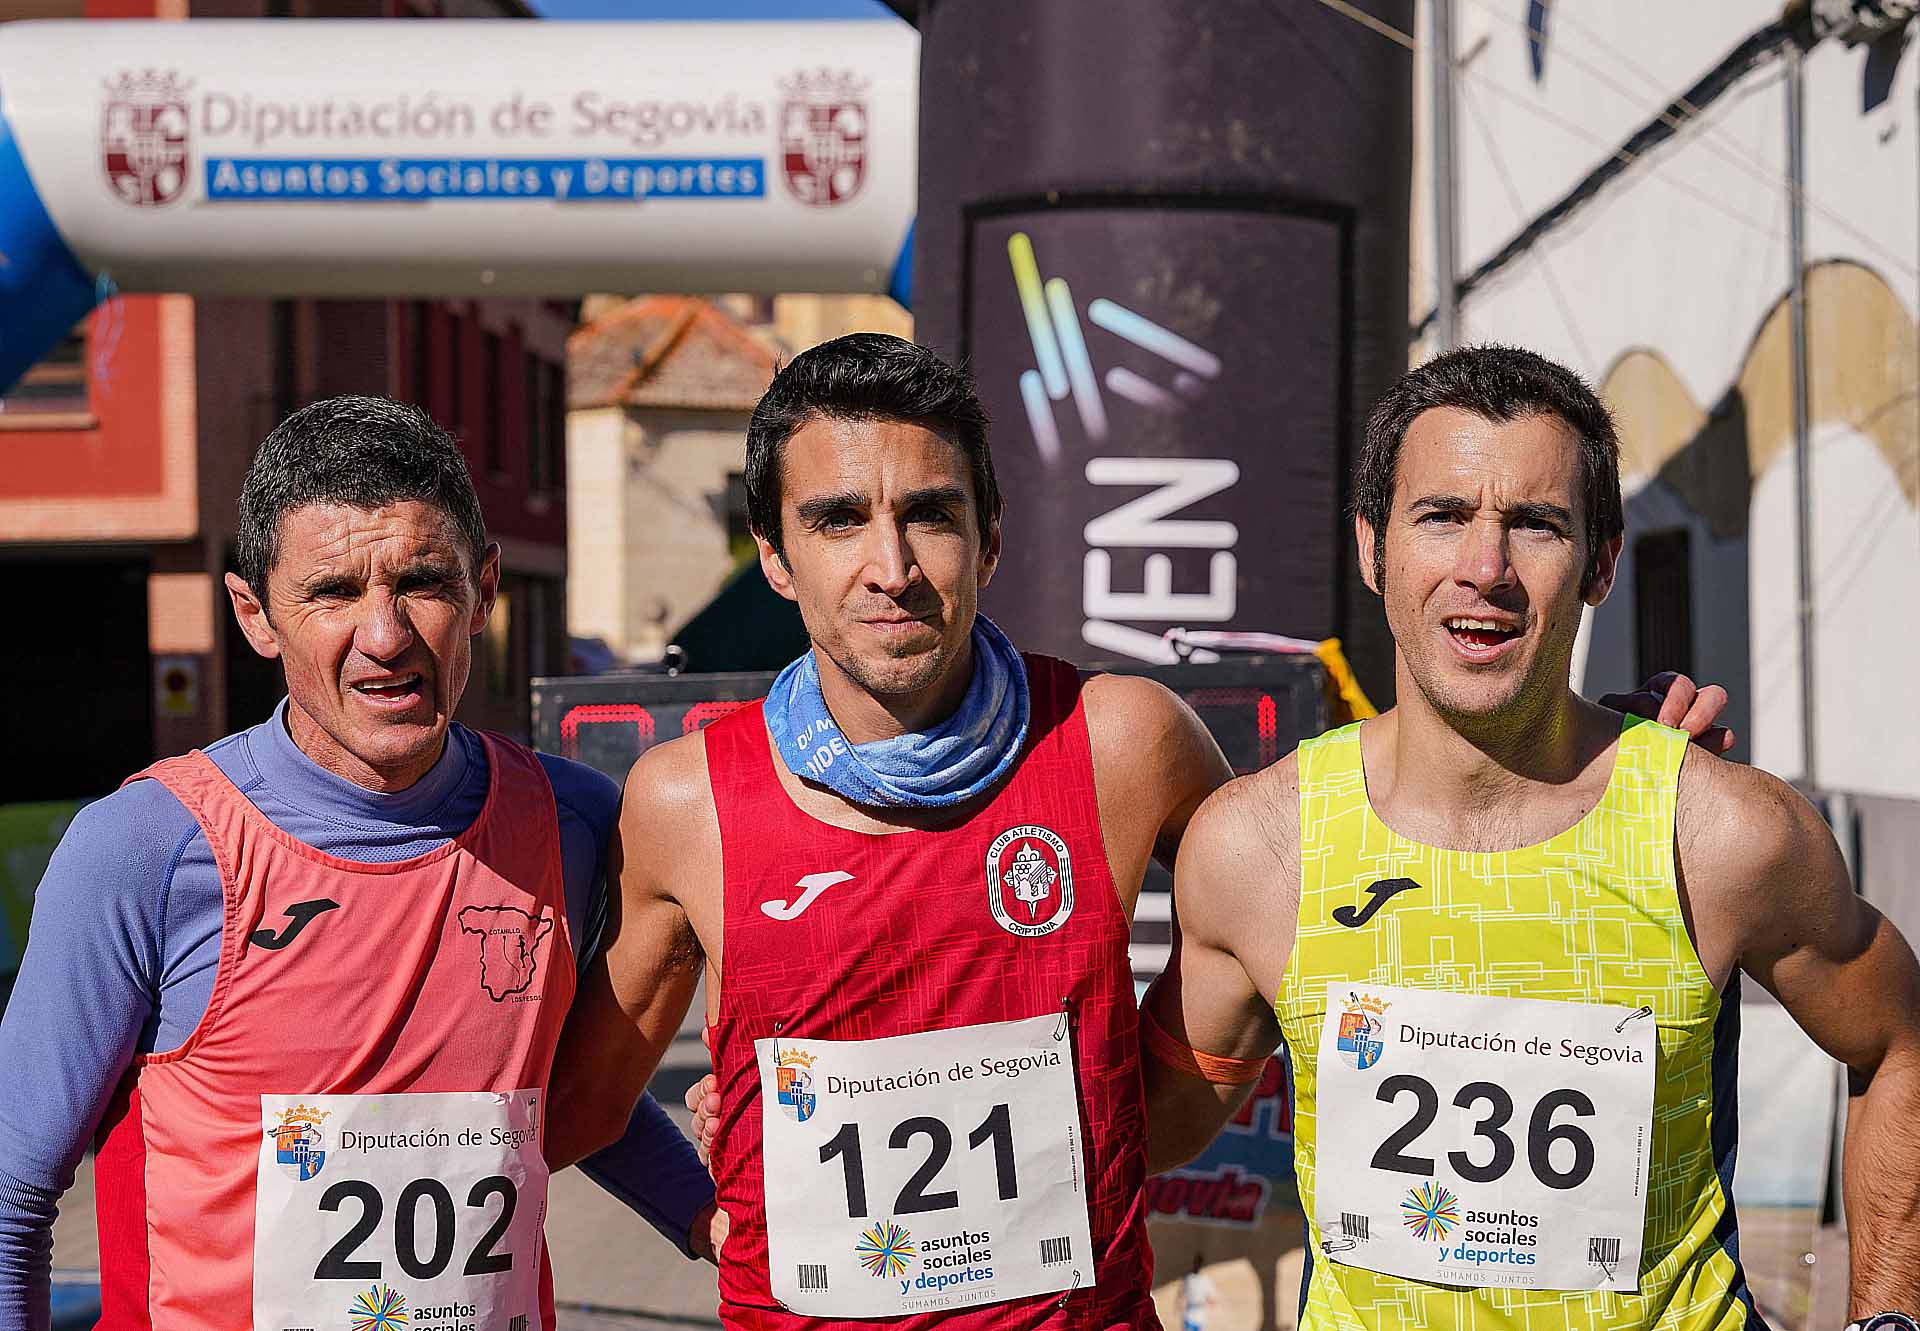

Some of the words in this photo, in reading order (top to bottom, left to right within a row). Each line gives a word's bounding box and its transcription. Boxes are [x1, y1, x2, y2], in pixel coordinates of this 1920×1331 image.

[201, 90, 474, 147] Diputación
[490, 93, 551, 136] de
[571, 89, 766, 147] Segovia
[212, 160, 369, 194] Asuntos
[378, 159, 542, 194] Sociales
[551, 166, 573, 201] y
[584, 159, 757, 201] Deportes
[991, 834, 1010, 858] CLUB
[1012, 828, 1064, 852] ATLETISMO
[1009, 921, 1058, 936] CRIPTANA
[1400, 1024, 1516, 1053] Diputación
[1524, 1036, 1551, 1056] de
[1560, 1039, 1643, 1066] Segovia
[827, 1067, 940, 1098] Diputación
[948, 1063, 974, 1082] de
[980, 1050, 1061, 1078] Segovia
[341, 1128, 450, 1154] Diputación
[457, 1127, 482, 1146] de
[489, 1127, 536, 1149] Segovia
[1370, 1074, 1596, 1189] 236
[818, 1103, 1018, 1218] 121
[1146, 1172, 1263, 1222] ovia
[313, 1175, 519, 1280] 202
[1465, 1210, 1539, 1228] asuntos
[921, 1230, 990, 1252] asuntos
[1464, 1227, 1537, 1246] sociales
[923, 1248, 992, 1270] sociales
[1438, 1247, 1449, 1262] y
[1453, 1243, 1536, 1266] deportes
[900, 1280, 910, 1295] y
[915, 1265, 994, 1291] deportes
[1437, 1270, 1487, 1283] SUMAMOS
[1494, 1274, 1535, 1284] JUNTOS
[414, 1301, 476, 1320] asuntos
[902, 1298, 950, 1310] SUMAMOS
[959, 1290, 997, 1302] JUNTOS
[414, 1319, 475, 1331] iales
